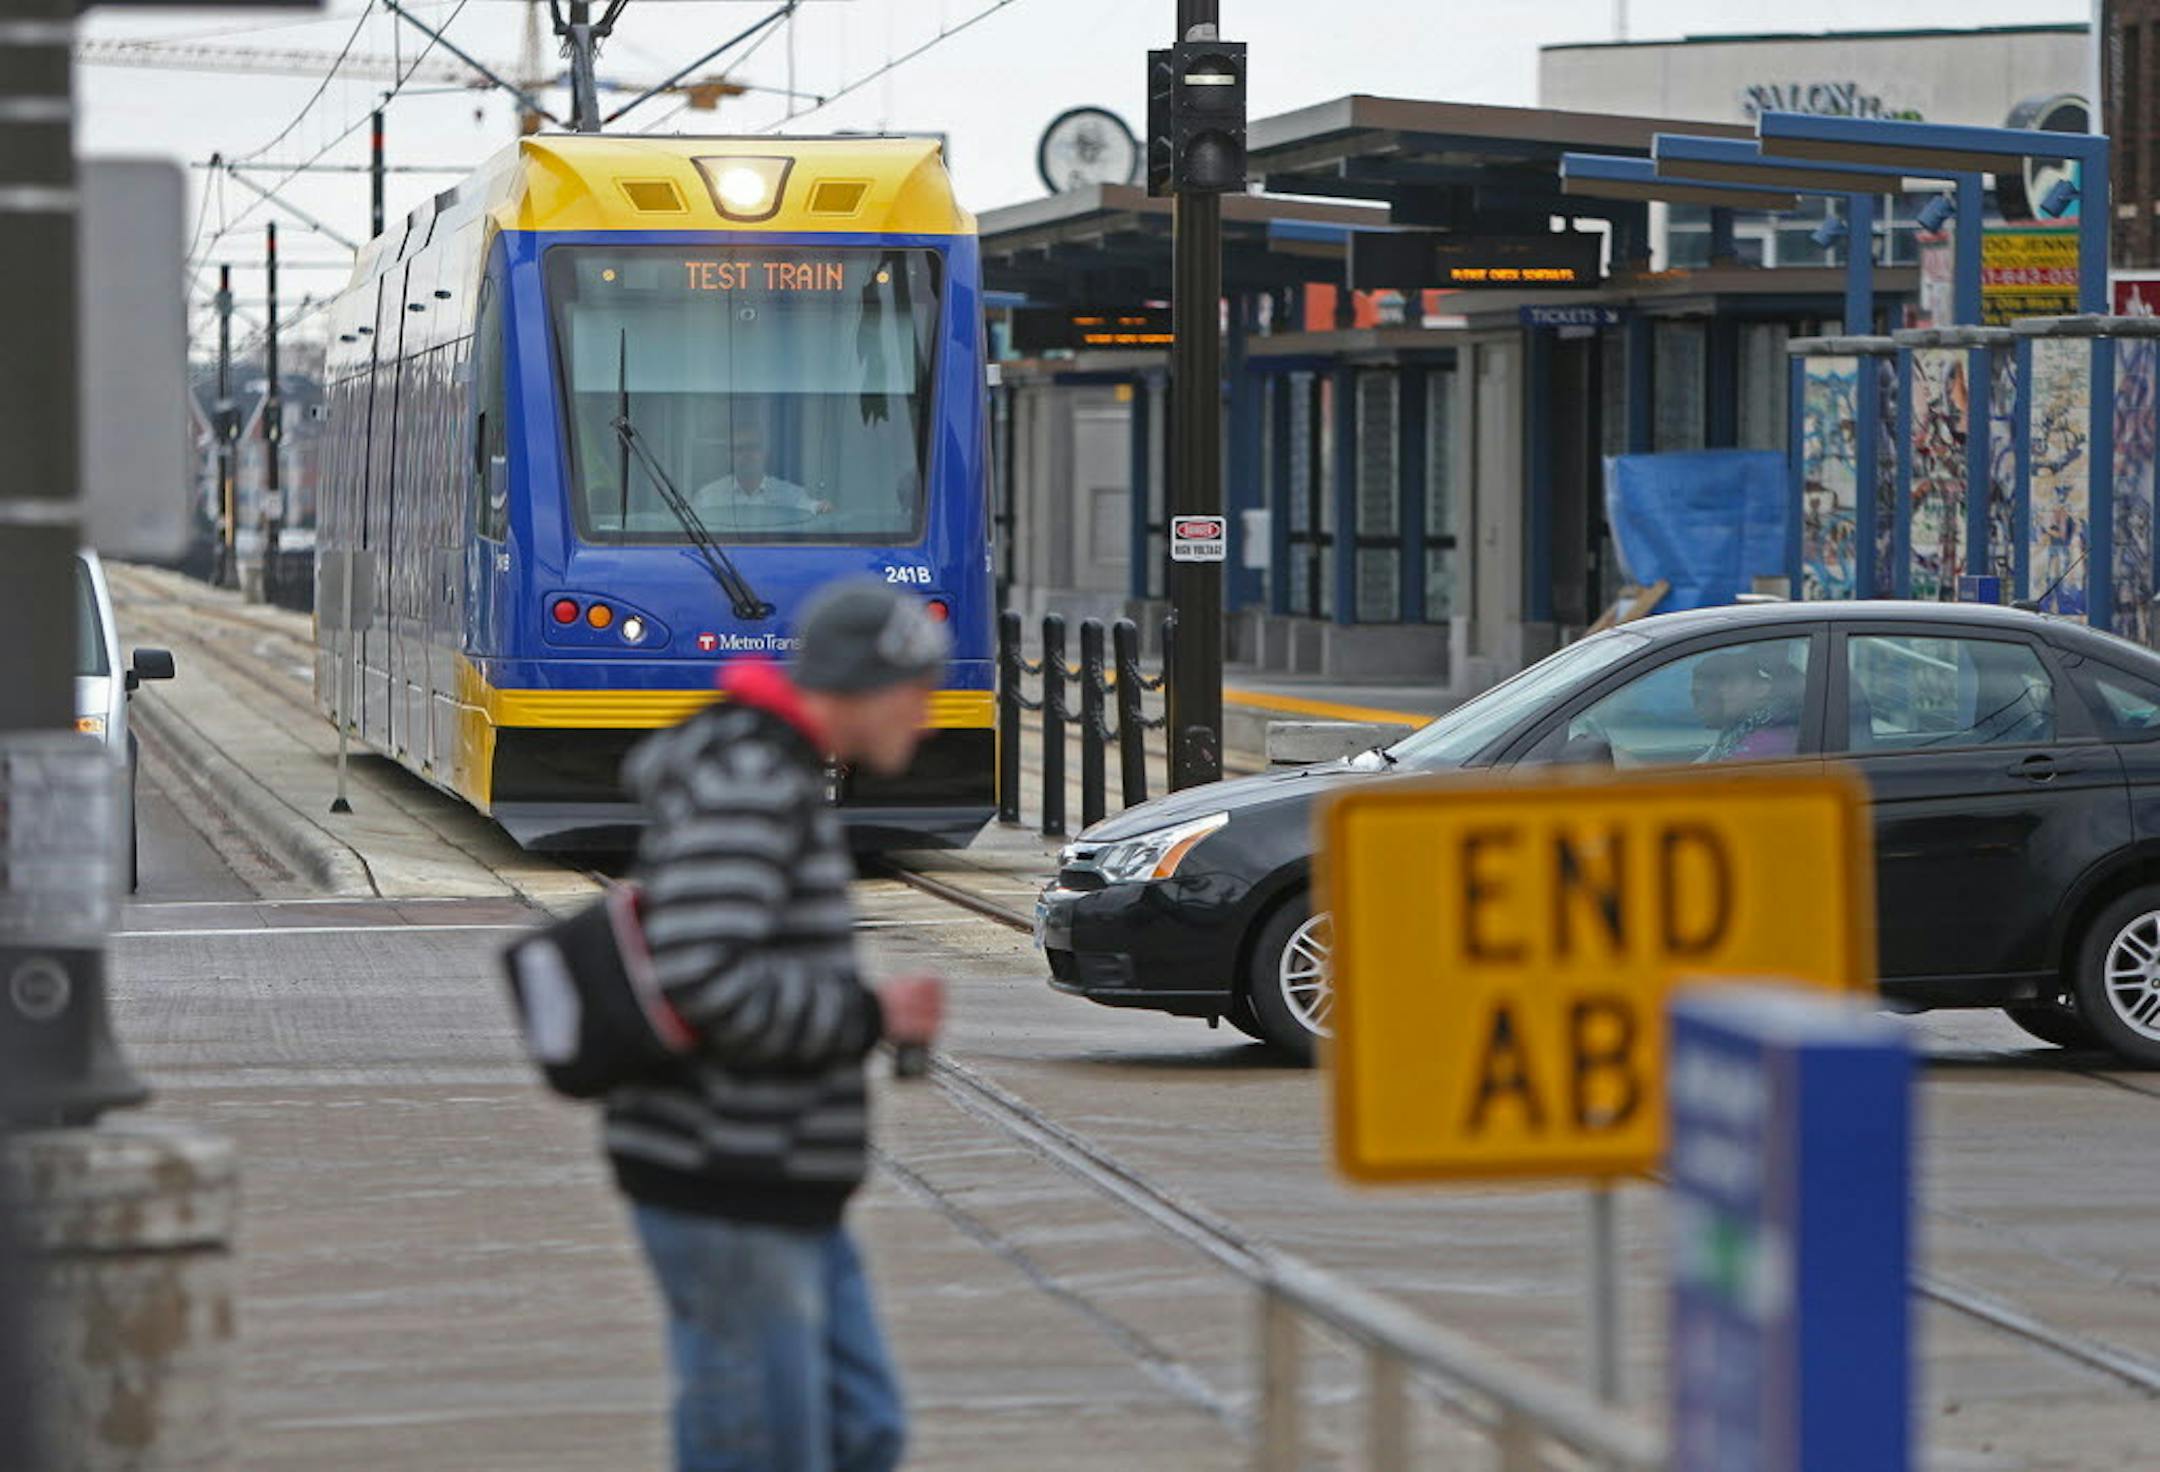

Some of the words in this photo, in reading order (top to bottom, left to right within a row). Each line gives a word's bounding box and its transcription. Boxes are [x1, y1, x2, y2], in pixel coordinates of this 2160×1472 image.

[685, 262, 751, 290] TEST
[763, 262, 844, 291] TRAIN
[1531, 307, 1599, 324] TICKETS
[885, 566, 931, 583] 241B
[719, 633, 802, 650] MetroTrans
[1457, 820, 1738, 966] END
[1462, 992, 1641, 1136] AB
